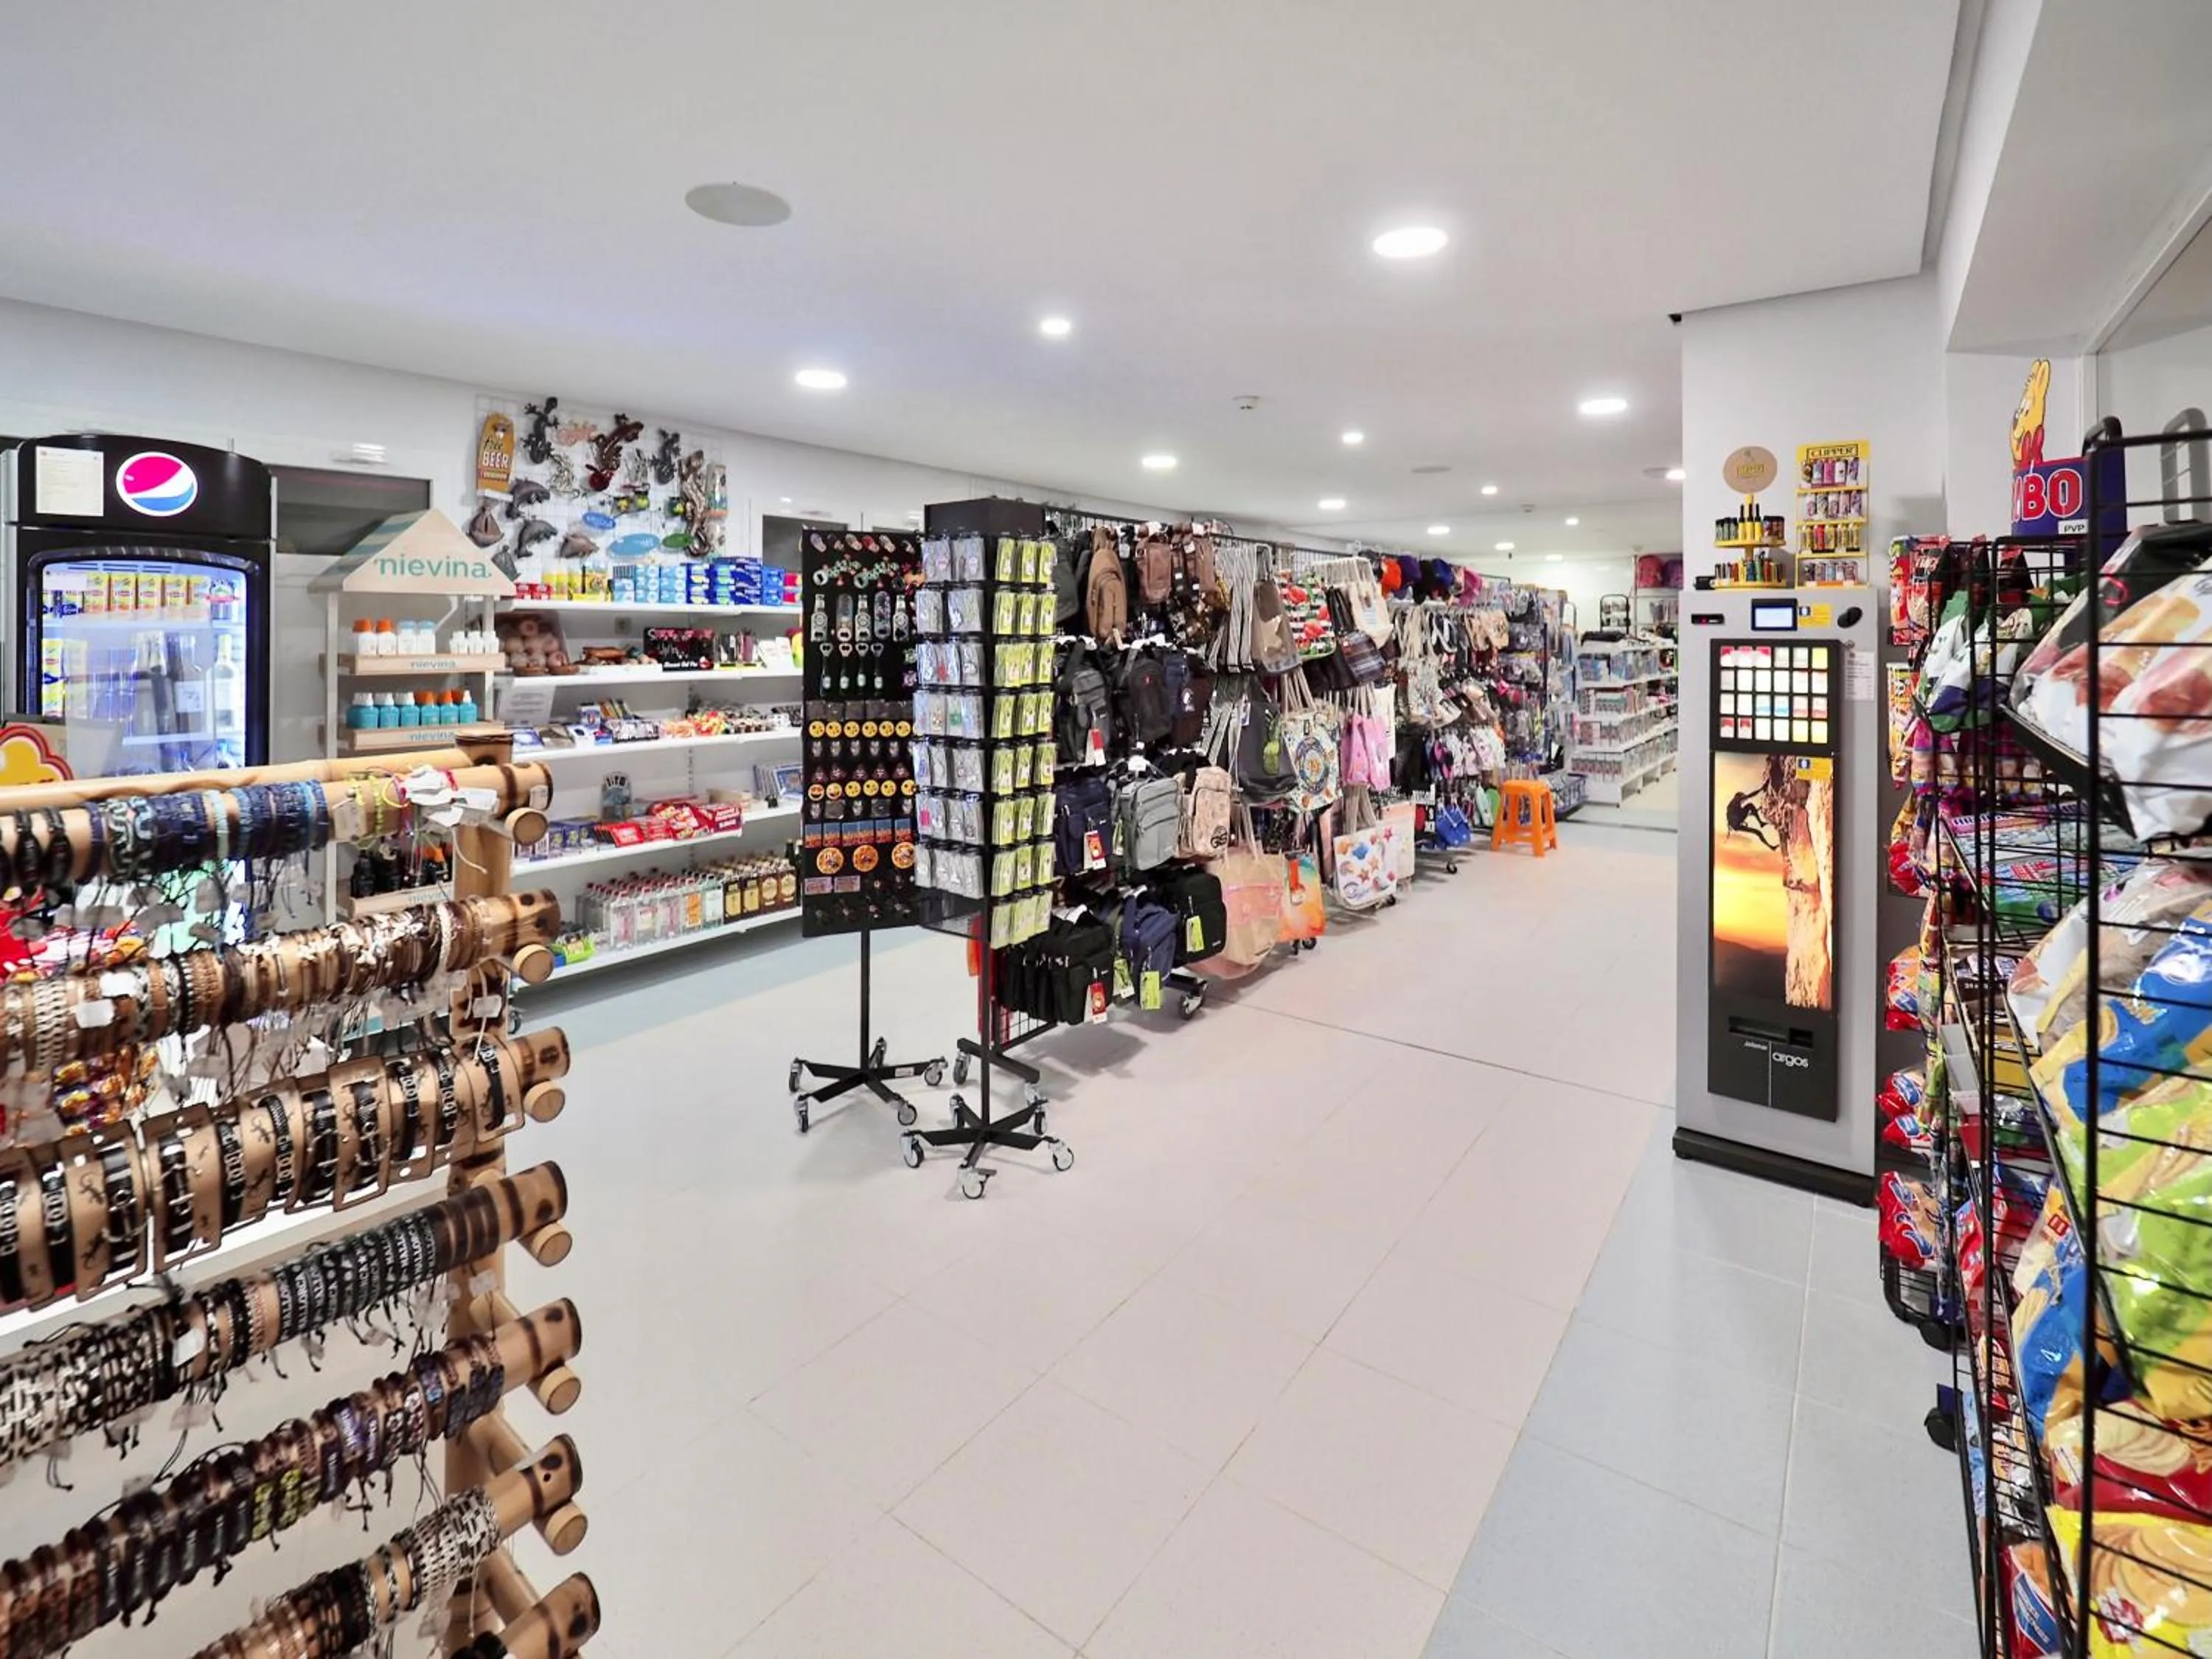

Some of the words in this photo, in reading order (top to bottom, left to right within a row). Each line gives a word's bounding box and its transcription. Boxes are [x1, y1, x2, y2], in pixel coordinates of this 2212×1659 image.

[482, 451, 509, 468] BEER
[2064, 524, 2085, 532] PVP
[378, 554, 491, 579] nievina
[1772, 1051, 1809, 1068] argos
